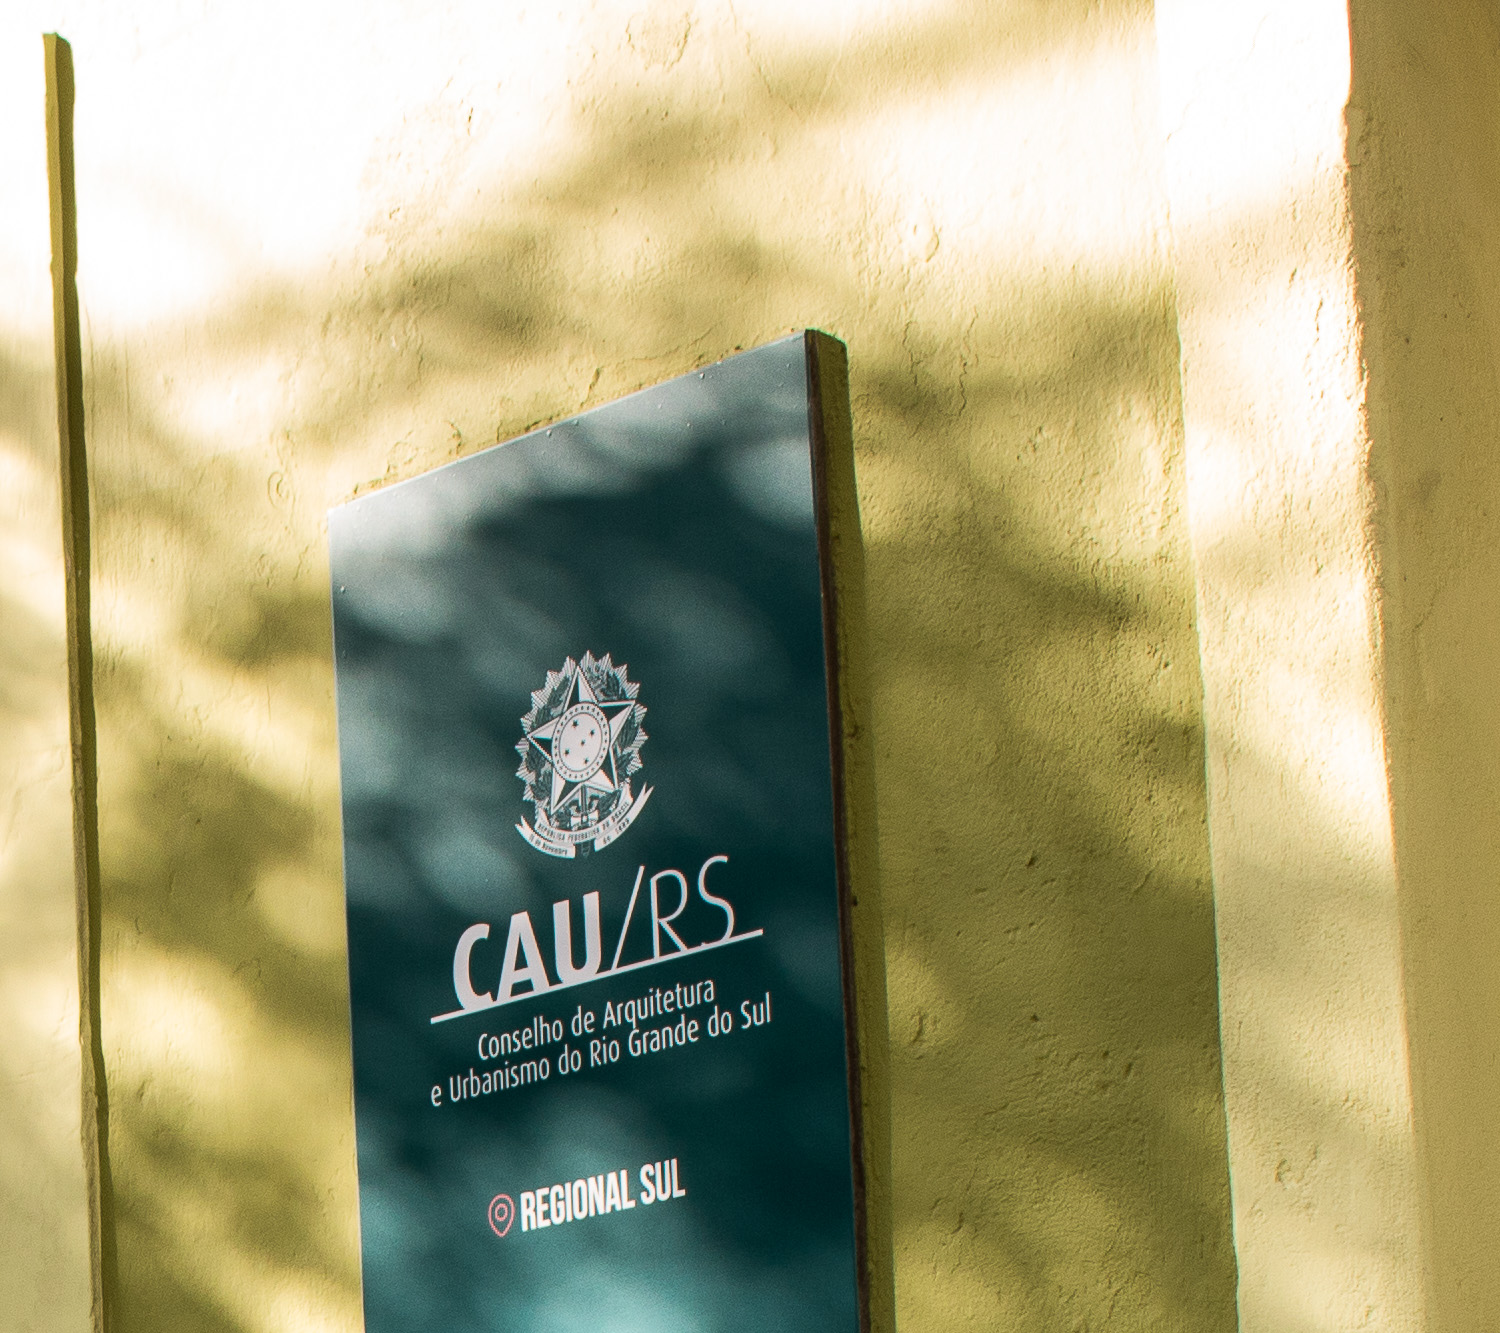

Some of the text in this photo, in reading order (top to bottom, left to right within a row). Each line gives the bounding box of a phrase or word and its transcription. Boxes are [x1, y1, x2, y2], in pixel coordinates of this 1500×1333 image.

[453, 855, 736, 1014] CAU/RS
[431, 992, 771, 1107] e Urbanismo do Rio Grande do Sul
[478, 979, 715, 1060] Conselho de Arquitetura
[519, 1158, 686, 1232] REGIONAL SUL
